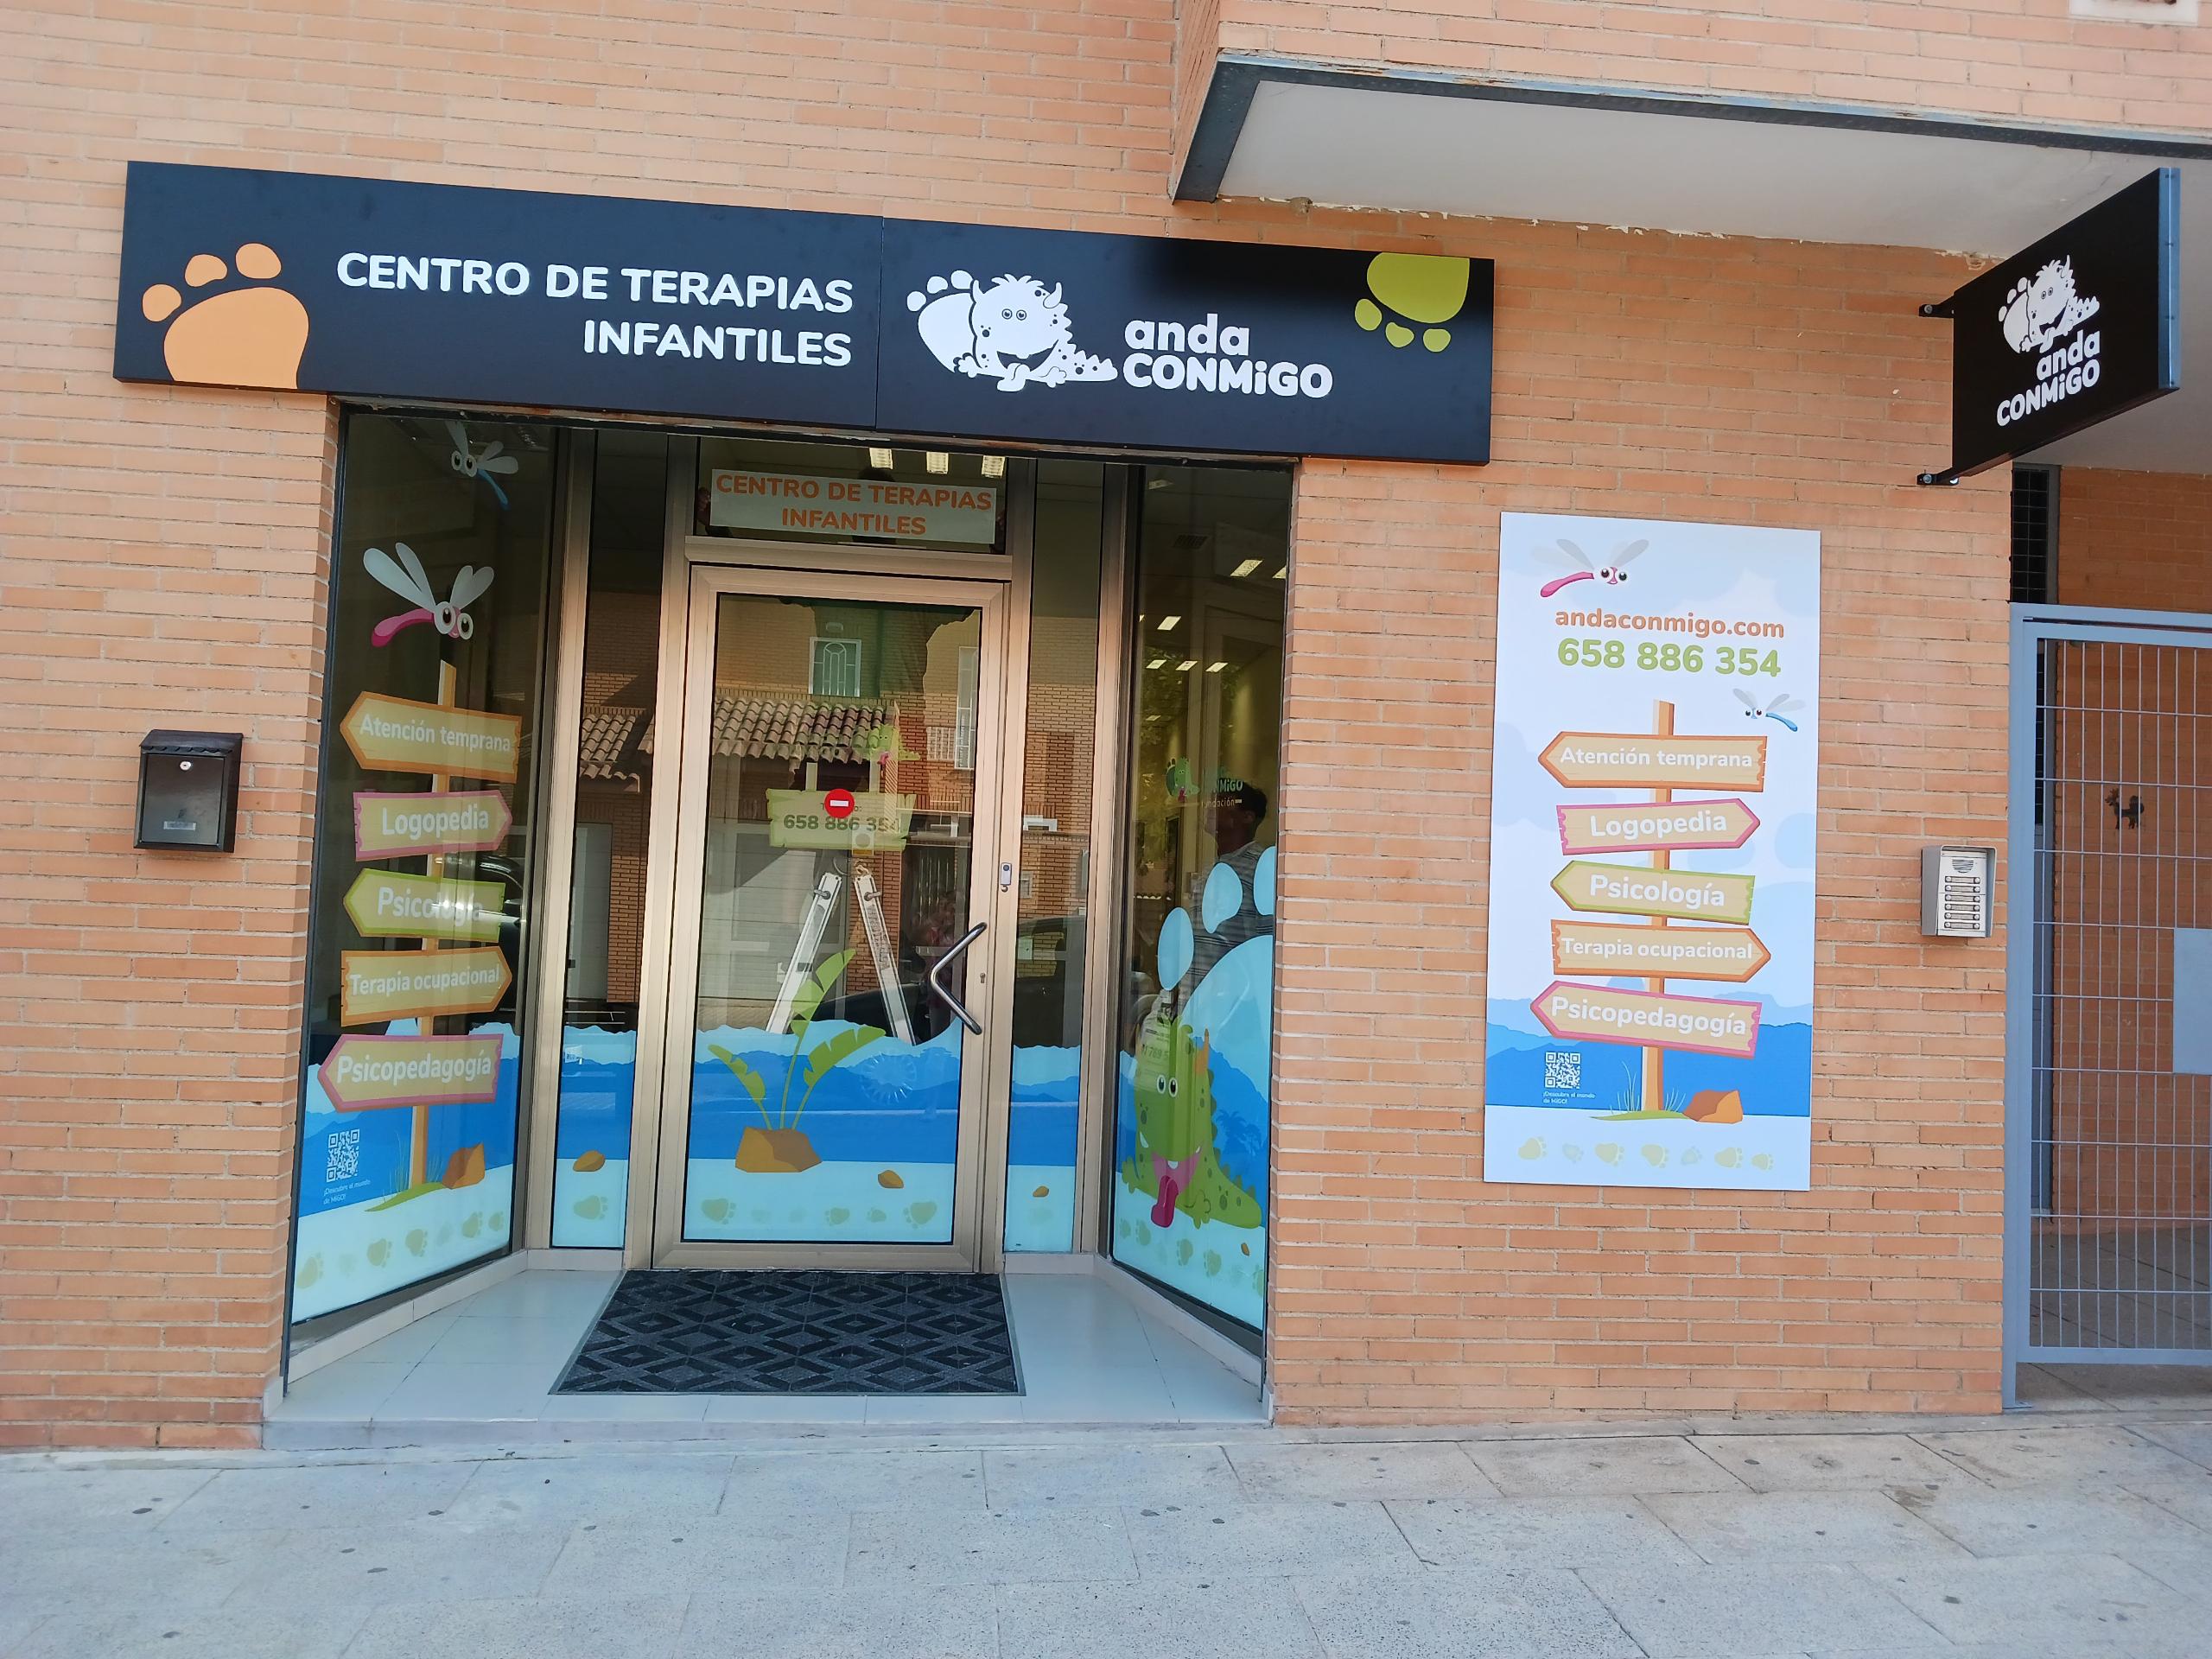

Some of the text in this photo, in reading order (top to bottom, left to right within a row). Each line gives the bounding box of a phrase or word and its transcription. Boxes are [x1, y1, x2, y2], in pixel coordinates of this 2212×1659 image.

[337, 251, 855, 314] CENTRO DE TERAPIAS
[583, 320, 853, 367] INFANTILES
[1124, 313, 1250, 358] anda
[2036, 329, 2101, 381] anda
[1123, 353, 1334, 399] CONMiGO
[1996, 359, 2101, 427] CONMiGO
[715, 474, 993, 512] CENTRO DE TERAPIAS
[781, 507, 927, 536] INFANTILES
[1554, 607, 1785, 639] andaconmigo.com
[1557, 638, 1782, 677] 658 886 354
[359, 712, 512, 753] Atención temprana
[1559, 746, 1753, 770] Atención temprana
[381, 803, 490, 841] Logopedia
[783, 814, 819, 830] 658
[824, 816, 861, 831] 886
[1589, 810, 1727, 840] Logopedia
[1589, 874, 1726, 910] Psicología
[1560, 937, 1753, 961] Terapia ocupacional
[350, 963, 500, 997] Terapia ocupacional
[1550, 995, 1747, 1038] Psicopedagogía
[336, 1049, 493, 1086] Psicopedagogía
